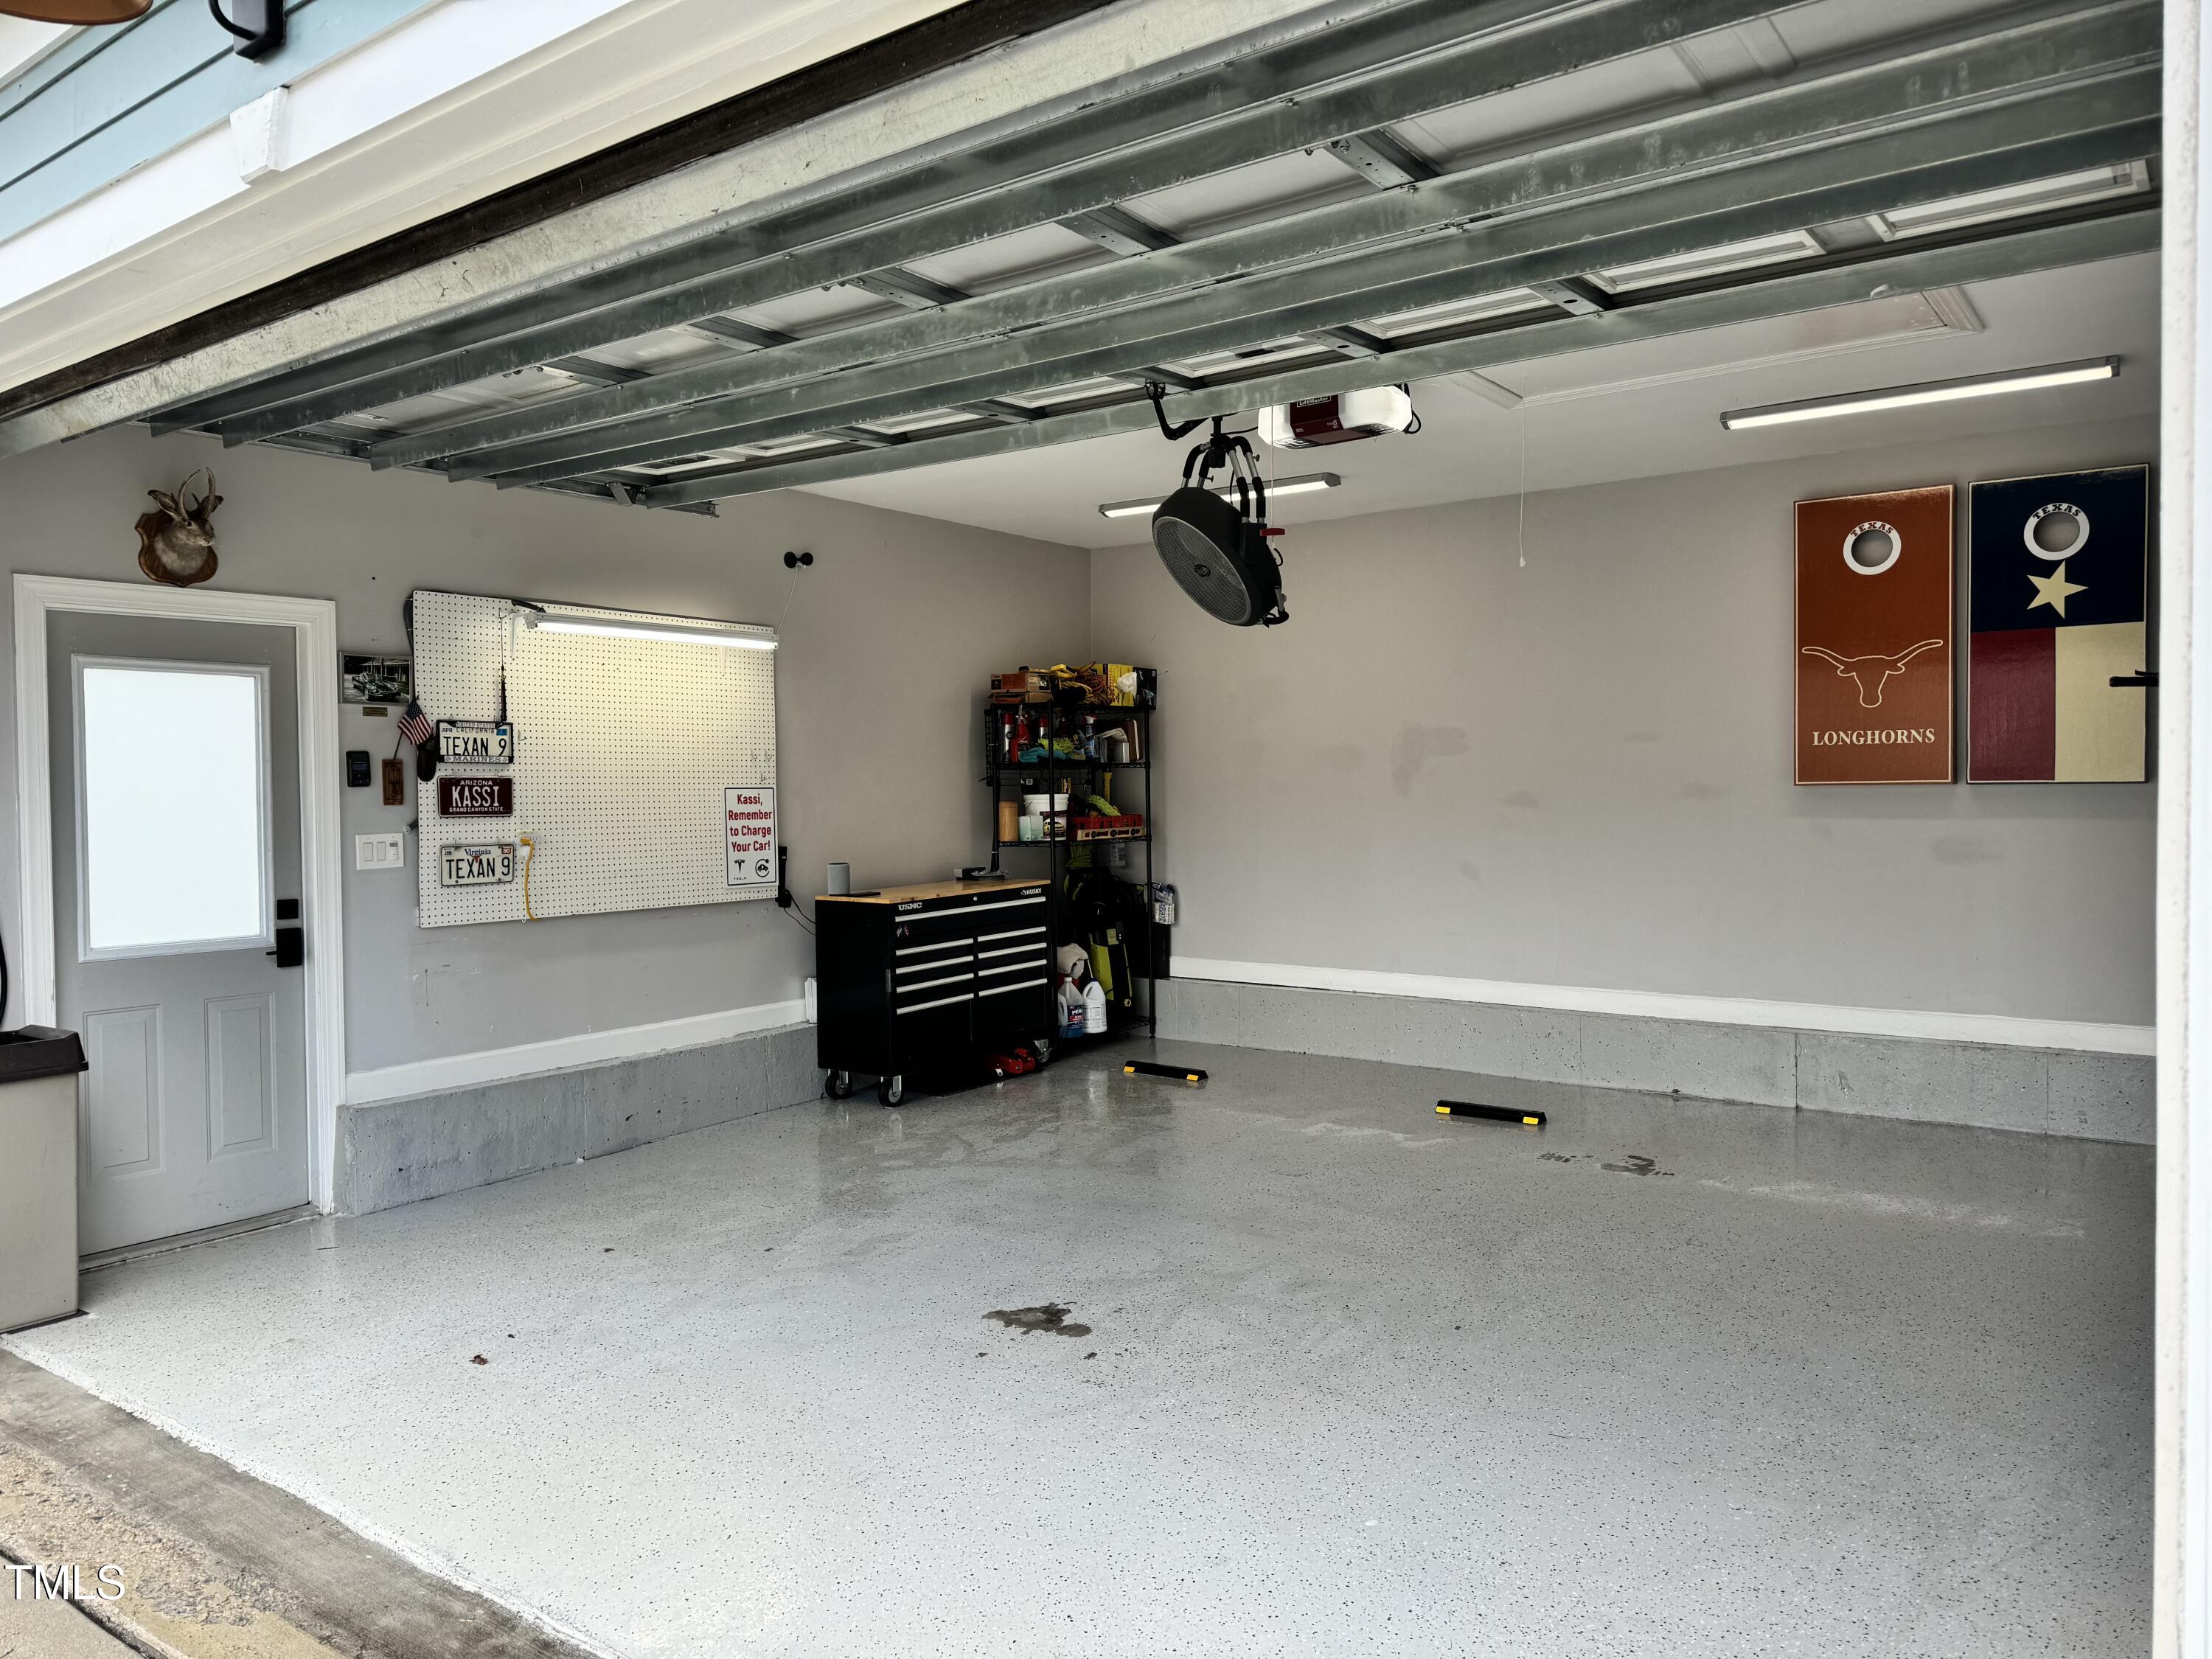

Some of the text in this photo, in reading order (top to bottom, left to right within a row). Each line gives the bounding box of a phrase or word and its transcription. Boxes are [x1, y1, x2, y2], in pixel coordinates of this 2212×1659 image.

[1299, 397, 1329, 406] LiftMaster
[2033, 504, 2081, 519] TEXAS
[1851, 522, 1893, 537] TEXAS
[1812, 728, 1935, 745] LONGHORNS
[443, 737, 507, 757] TEXAN 9
[452, 786, 499, 807] KASSI
[737, 793, 763, 806] Kassi,
[728, 810, 772, 821] Remember
[730, 825, 771, 838] to Charge
[731, 841, 771, 852] Your Car!
[446, 857, 510, 879] TEXAN 9
[898, 902, 922, 911] USMC
